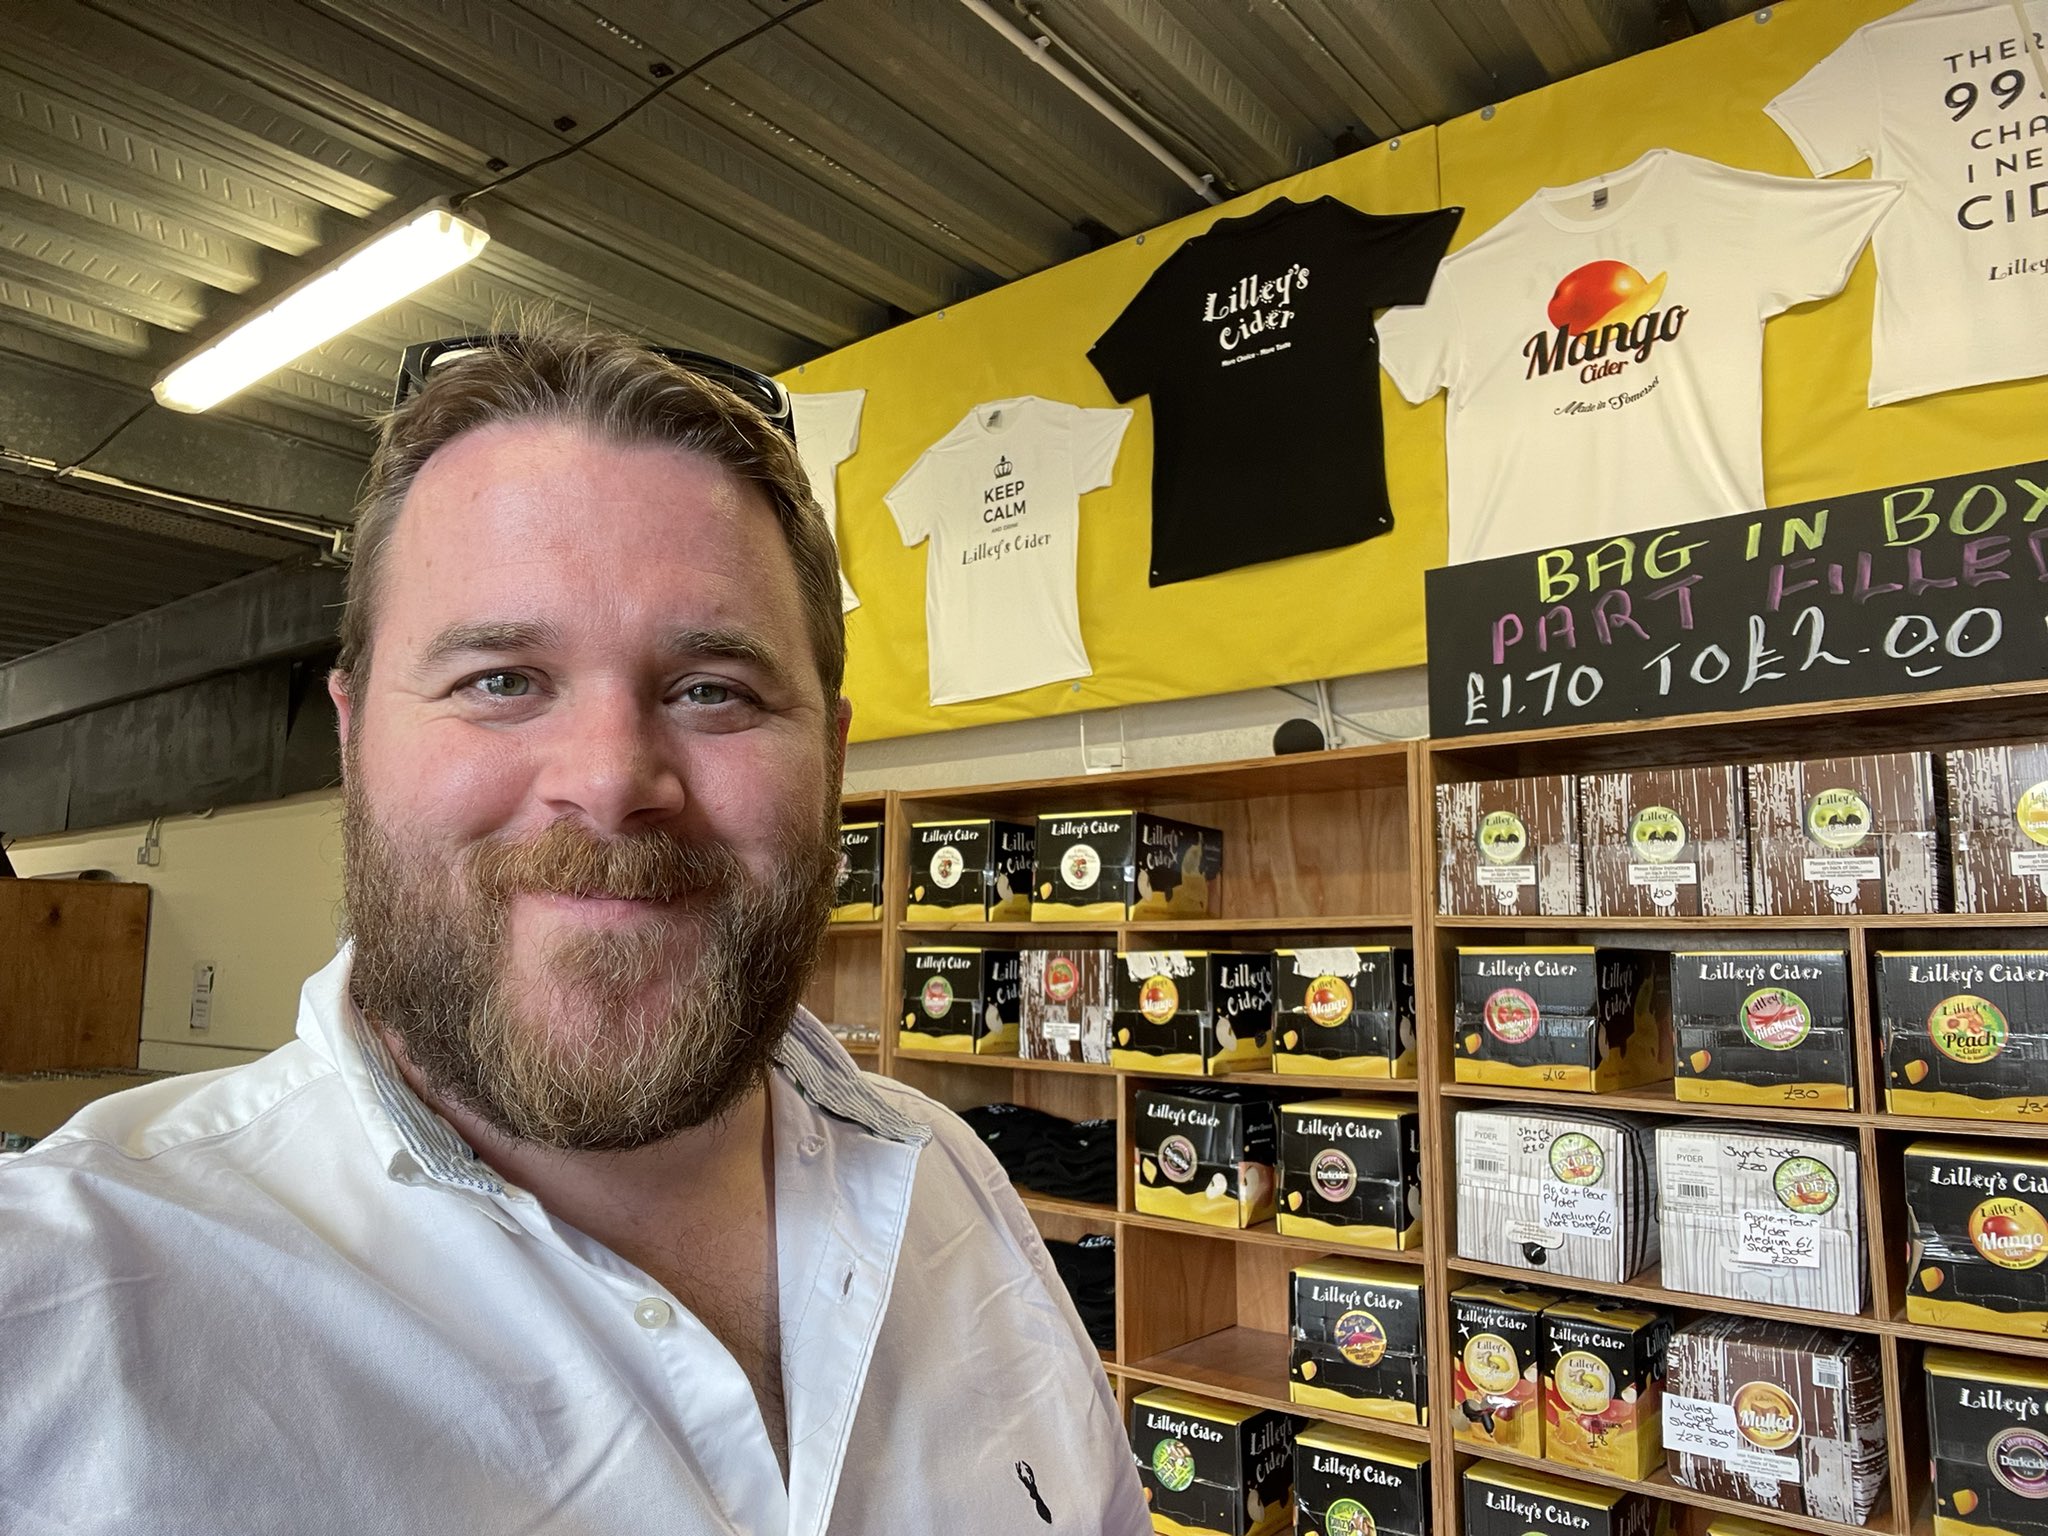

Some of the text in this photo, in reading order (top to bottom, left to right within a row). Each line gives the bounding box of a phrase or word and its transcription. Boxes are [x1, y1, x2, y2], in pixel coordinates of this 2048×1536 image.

[1971, 115, 2048, 149] CHA
[1968, 148, 2043, 183] I NE
[1957, 181, 2048, 230] CID
[1202, 264, 1310, 322] Lilley's
[1219, 310, 1295, 350] Cider
[1522, 304, 1689, 380] Mango
[1580, 359, 1628, 384] Cider
[1554, 376, 1660, 416] Made in Somerset
[983, 480, 1025, 504] KEEP
[983, 500, 1026, 523] CALM
[962, 532, 1052, 565] Lilley's Cider
[1536, 478, 2048, 604] BAG IN BOX
[1492, 574, 1704, 664] PART
[1465, 663, 1604, 726] £1.70
[1642, 642, 1730, 697] TO
[846, 833, 870, 846] Cider
[922, 828, 980, 845] Lilley's Cider
[1050, 820, 1120, 839] Lilley's Cider
[916, 956, 972, 973] Lilley's Cider
[1477, 960, 1578, 982] Lilley's Cider
[1699, 962, 1822, 986] Lilley's Cider
[1909, 963, 2048, 989] Lilley's Cider
[1228, 990, 1264, 1016] Cider
[1310, 998, 1348, 1016] Mango
[1754, 1011, 1805, 1040] Rhubarb
[1942, 1031, 1997, 1048] Peach
[1784, 1084, 1820, 1100] £30
[1147, 1103, 1220, 1128] Lilley's Cider
[1296, 1118, 1342, 1141] Lilley's
[1344, 1122, 1382, 1140] Cider
[1554, 1154, 1602, 1174] PYDER
[1676, 1154, 1704, 1163] PYDER
[1780, 1180, 1836, 1200] PYDER
[1930, 1166, 2008, 1196] Lilley's
[1582, 1187, 1608, 1200] Pear
[1550, 1211, 1596, 1222] Medium
[1980, 1203, 2024, 1218] Lilley's
[1744, 1234, 1790, 1246] Medium
[1978, 1232, 2044, 1252] Mango
[1312, 1286, 1403, 1310] Lilley's Cider
[1456, 1308, 1528, 1331] Lilley's Cider
[1550, 1326, 1625, 1350] Lilley's Cider
[1959, 1388, 2040, 1421] Lilley's
[1146, 1413, 1224, 1443] Lilley's Cider
[1740, 1410, 1794, 1432] Mulled
[1312, 1455, 1402, 1488] Lilley's Cider
[1486, 1490, 1591, 1530] Lilley's Cider
